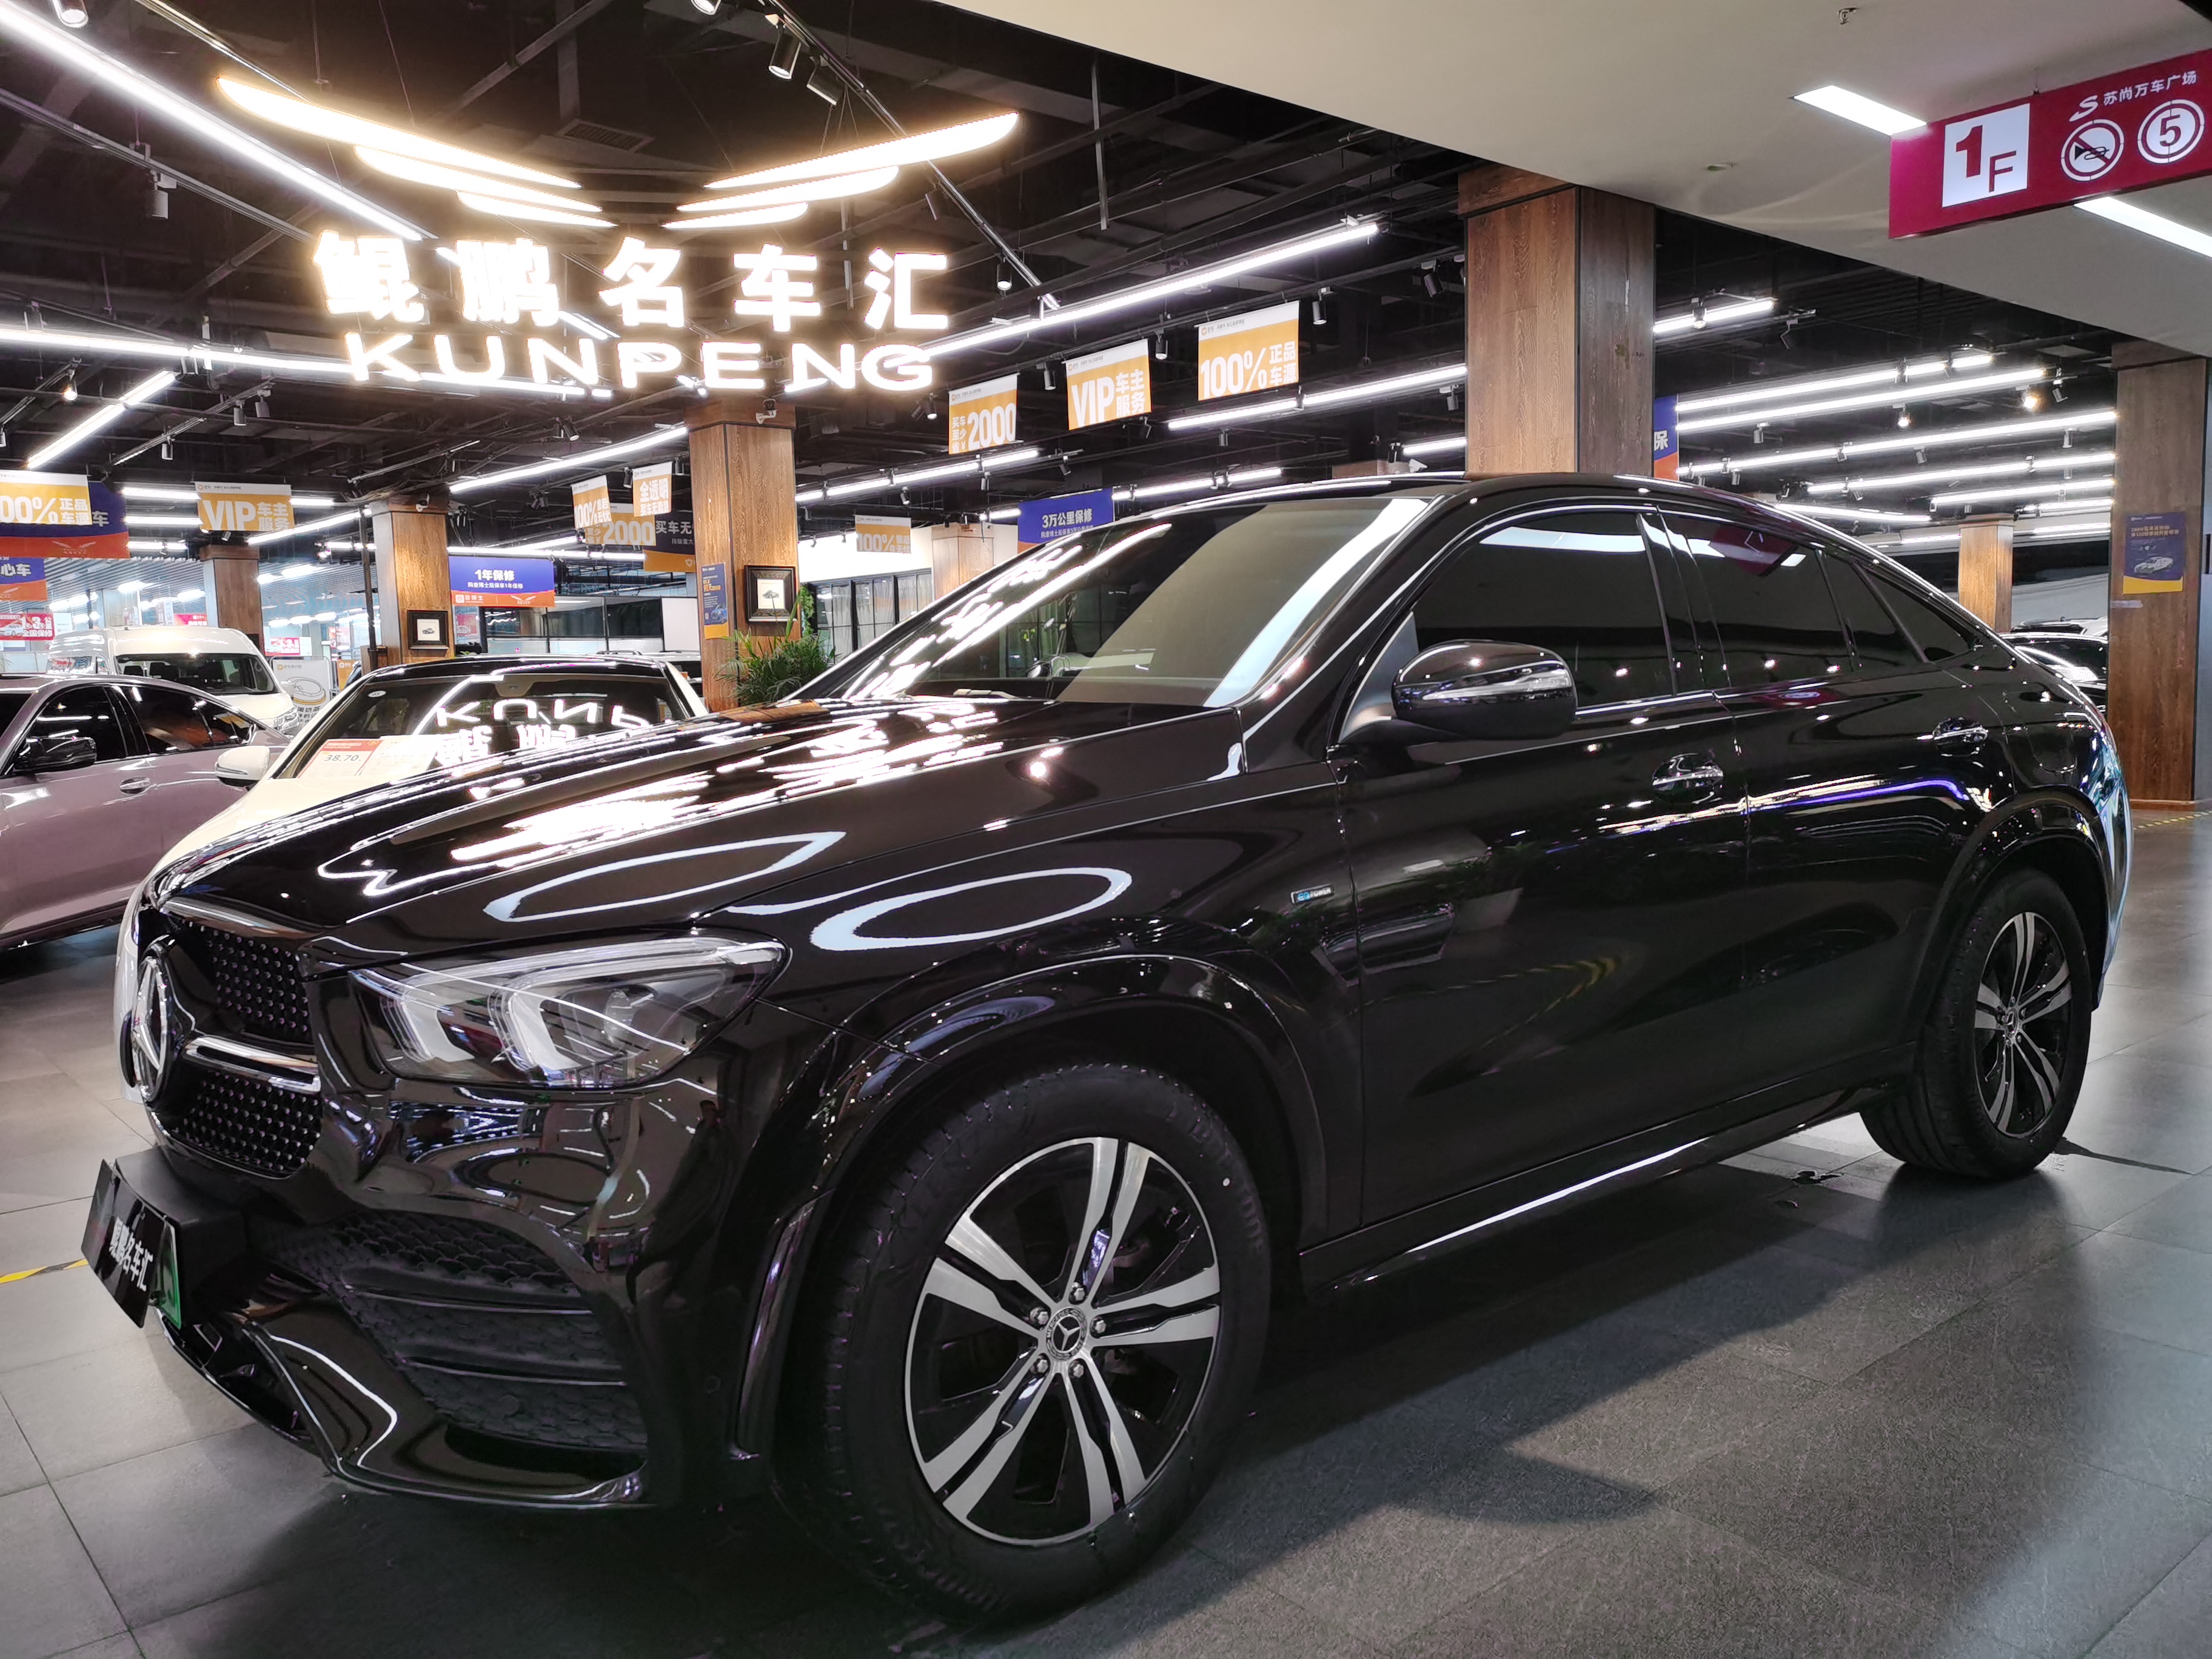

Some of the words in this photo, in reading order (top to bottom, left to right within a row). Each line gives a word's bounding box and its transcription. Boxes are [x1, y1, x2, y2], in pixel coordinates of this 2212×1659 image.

[2103, 70, 2197, 106] 苏尚万车广场
[2159, 114, 2182, 147] 5
[313, 229, 949, 333] 鲲鹏名车汇
[344, 332, 935, 391] KUNPENG
[1269, 341, 1296, 364] 正品
[1116, 369, 1145, 394] 车主
[1201, 347, 1267, 399] 100%
[1270, 362, 1296, 386] 车源
[1071, 377, 1114, 428] VIP
[1116, 392, 1145, 417] 服务
[952, 415, 966, 428] 买车
[967, 403, 1016, 451] 2000
[952, 427, 967, 441] 至少
[639, 477, 669, 503] 全透明
[59, 498, 88, 511] 正品
[202, 500, 256, 531] VIP
[257, 501, 289, 517] 车主
[61, 511, 90, 525] 车源
[258, 517, 289, 531] 服务
[656, 520, 694, 535] 买车无
[1042, 508, 1093, 529] 3万公里保修
[603, 520, 655, 545] 2000
[475, 569, 515, 581] 1年保修
[1298, 891, 1310, 901] EQ
